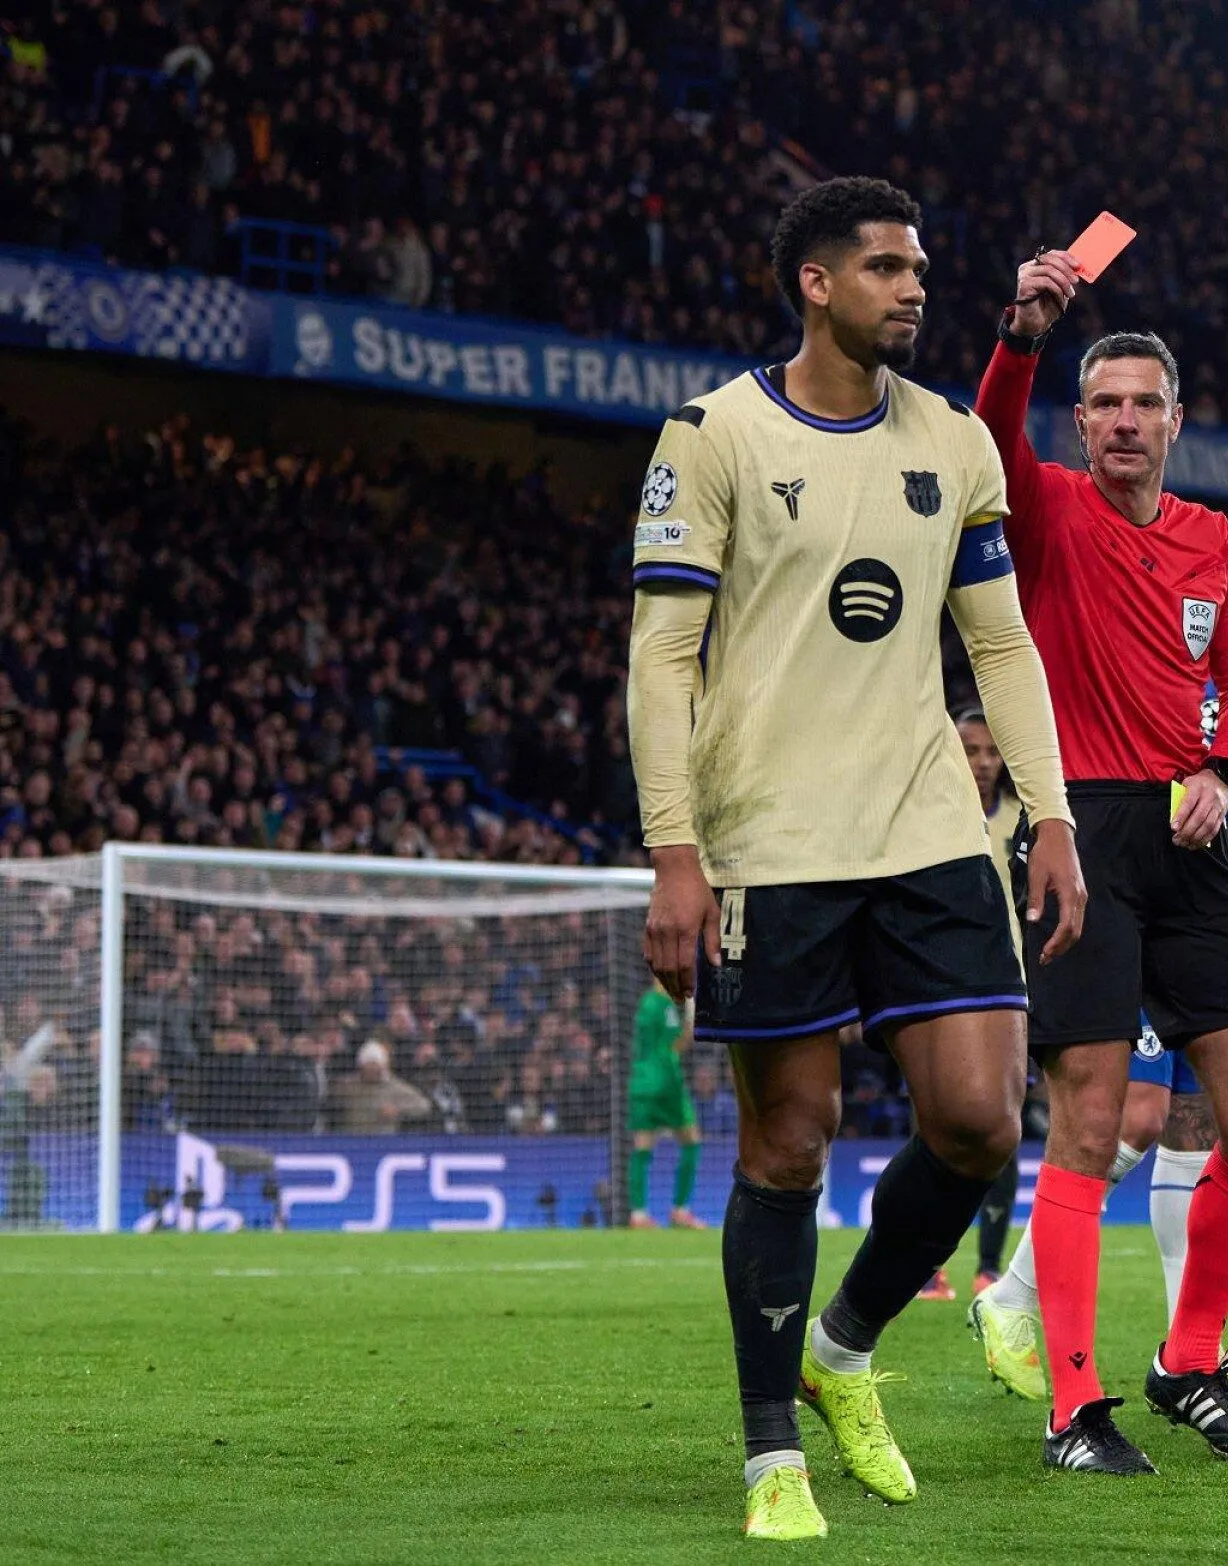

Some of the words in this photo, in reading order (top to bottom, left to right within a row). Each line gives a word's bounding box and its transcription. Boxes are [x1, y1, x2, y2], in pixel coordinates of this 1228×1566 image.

[352, 317, 531, 397] SUPER
[1188, 604, 1211, 620] UEFA
[1189, 623, 1208, 634] MATCH
[273, 1153, 507, 1232] PS5
